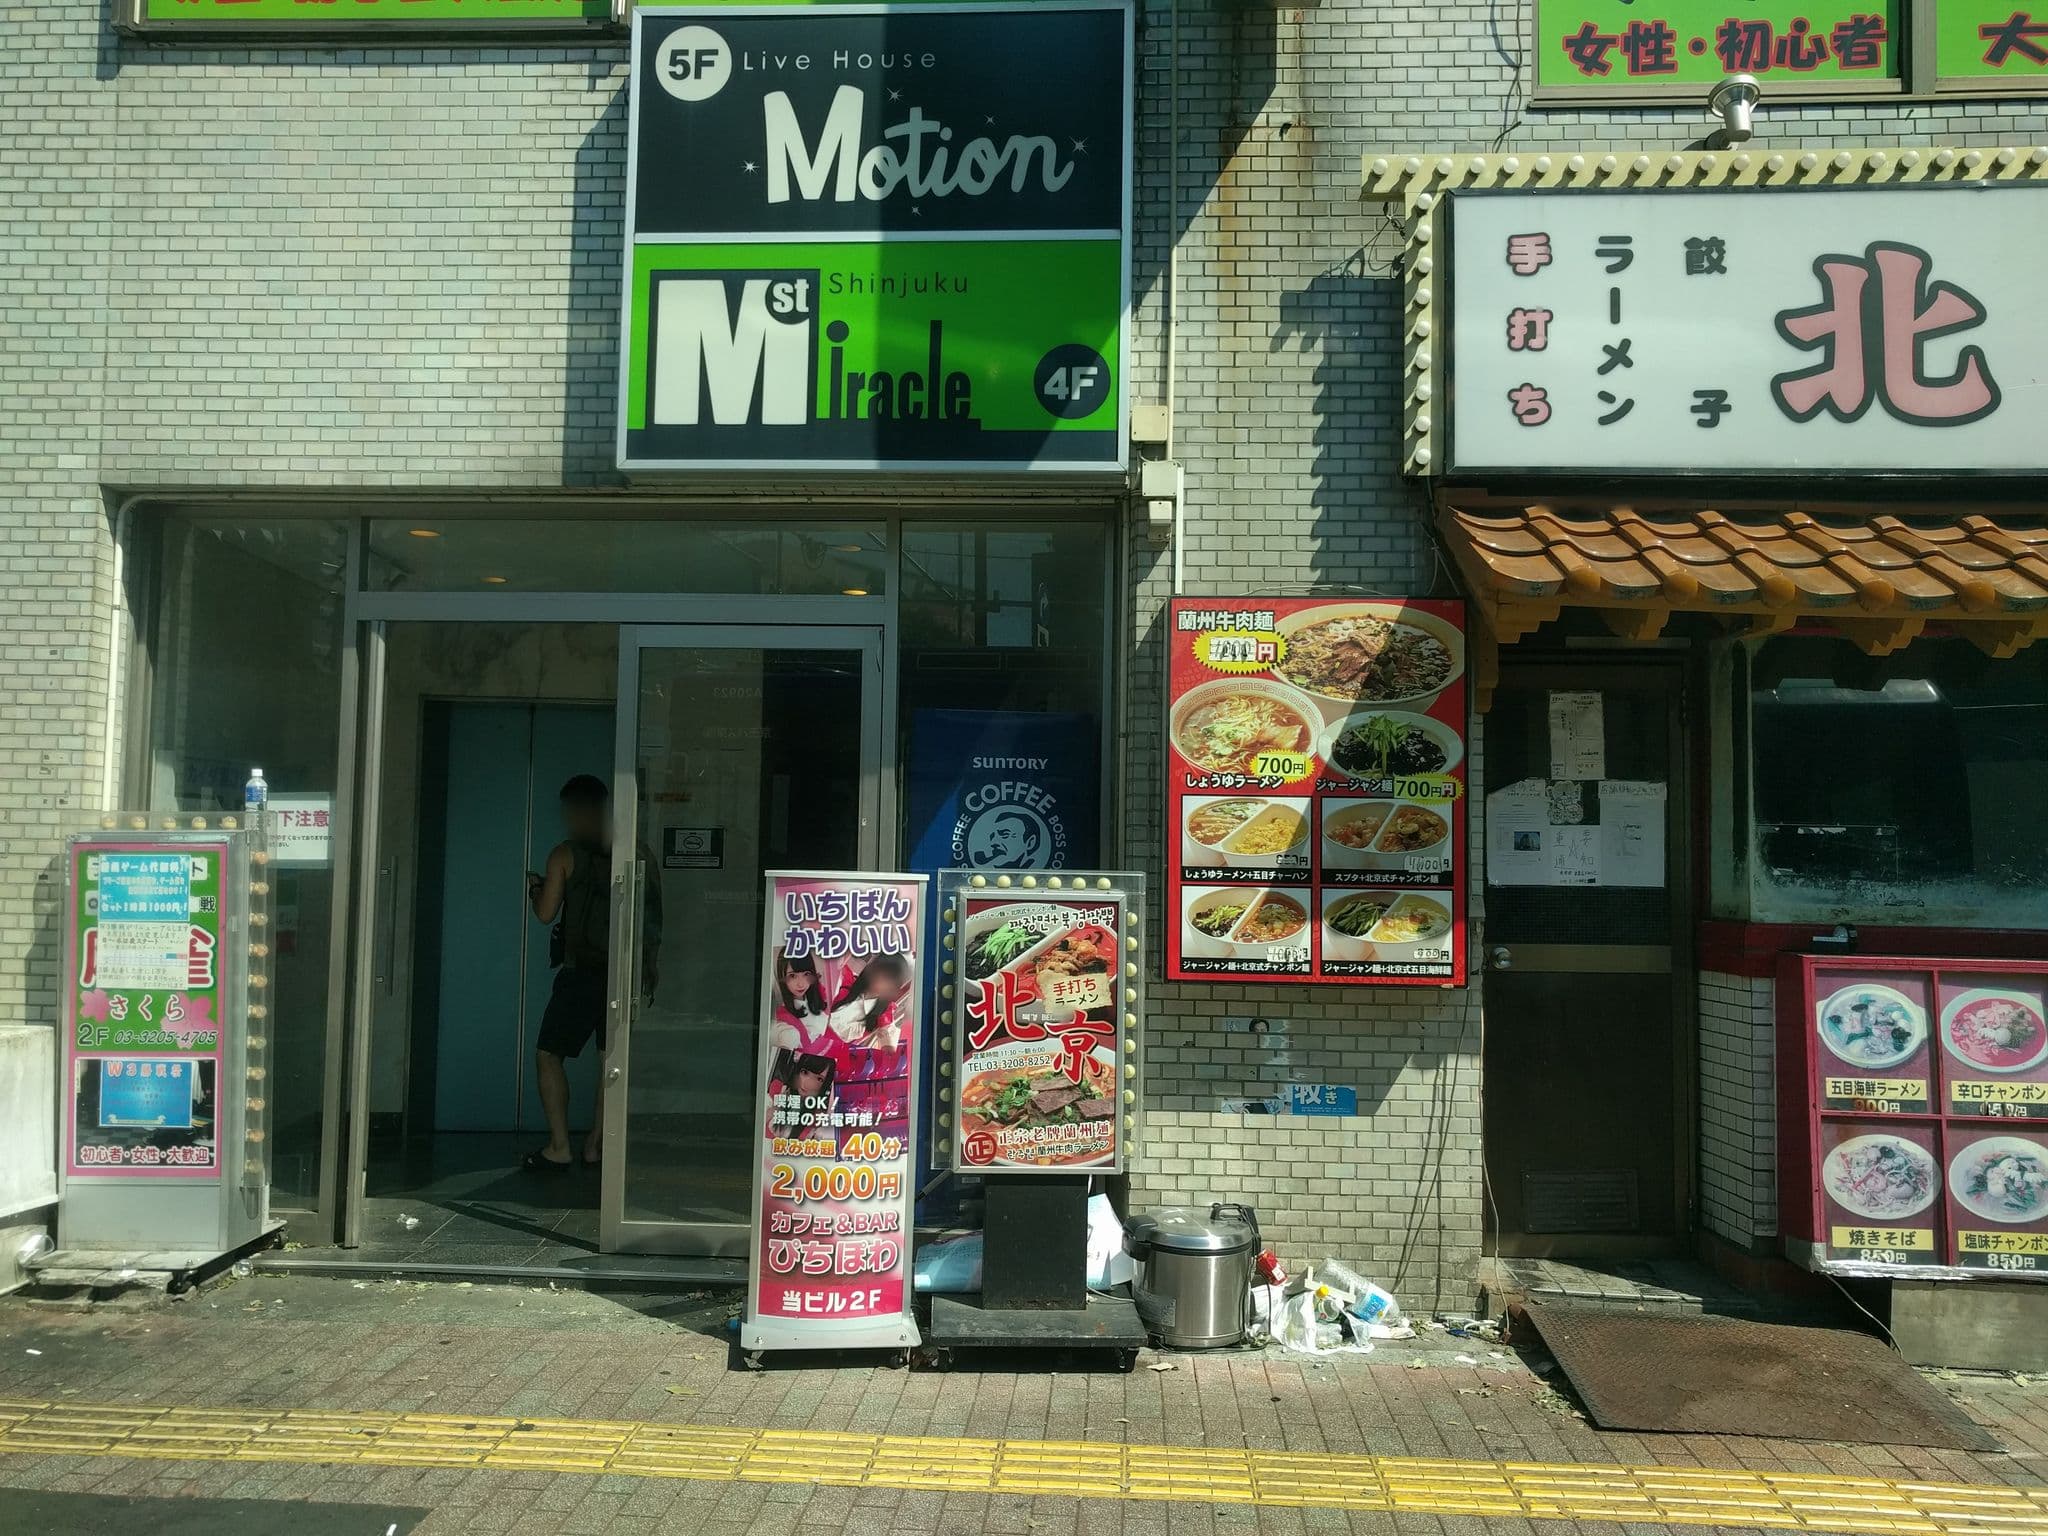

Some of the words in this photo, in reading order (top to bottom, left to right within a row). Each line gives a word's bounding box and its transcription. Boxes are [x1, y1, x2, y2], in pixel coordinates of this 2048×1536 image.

[1562, 15, 1888, 75] 女性・初心者
[668, 49, 718, 81] 5F
[743, 50, 811, 71] Live
[833, 49, 936, 69] House
[764, 85, 1075, 204] Motion
[828, 272, 970, 299] Shinjuku
[1506, 232, 1553, 427] 手打ち
[1594, 234, 1636, 426] ラーメン
[1683, 236, 1732, 428] 餃子
[1770, 240, 2002, 427] 北
[1043, 366, 1099, 401] 4F
[972, 757, 1049, 770] SUNTORY
[1258, 757, 1305, 775] 700円
[1186, 774, 1284, 790] しょうゆラーメン
[1315, 779, 1393, 792] ジャージャン麺
[965, 781, 1057, 815] COFFEE
[952, 813, 972, 861] COFFEE
[1048, 815, 1067, 848] BOSS
[1184, 869, 1308, 881] しょうゆラーメン+五目チャーハン
[784, 888, 910, 922] いちばん
[784, 924, 910, 958] かわいい
[1053, 977, 1097, 996] 手打ち
[1055, 993, 1100, 1006] ラーメン
[109, 994, 184, 1022] さくら
[78, 1023, 110, 1046] 2F
[114, 1030, 218, 1045] 03-3205-4705
[1831, 1080, 1922, 1097] 五目海鮮ラーメン
[1957, 1083, 2047, 1101] 辛口チャンポン
[772, 1111, 882, 1127] 携帯の充電可能!
[81, 1146, 210, 1164] 初心者・女性・大歓迎
[772, 1138, 837, 1157] 飲み放題
[841, 1132, 901, 1162] 40分
[770, 1163, 900, 1204] 2,000円
[770, 1210, 898, 1236] カフェ&BAR
[1848, 1229, 1917, 1247] 焼きそば
[768, 1239, 898, 1275] ぴちぽわ
[782, 1289, 882, 1313] 当ビル2F
